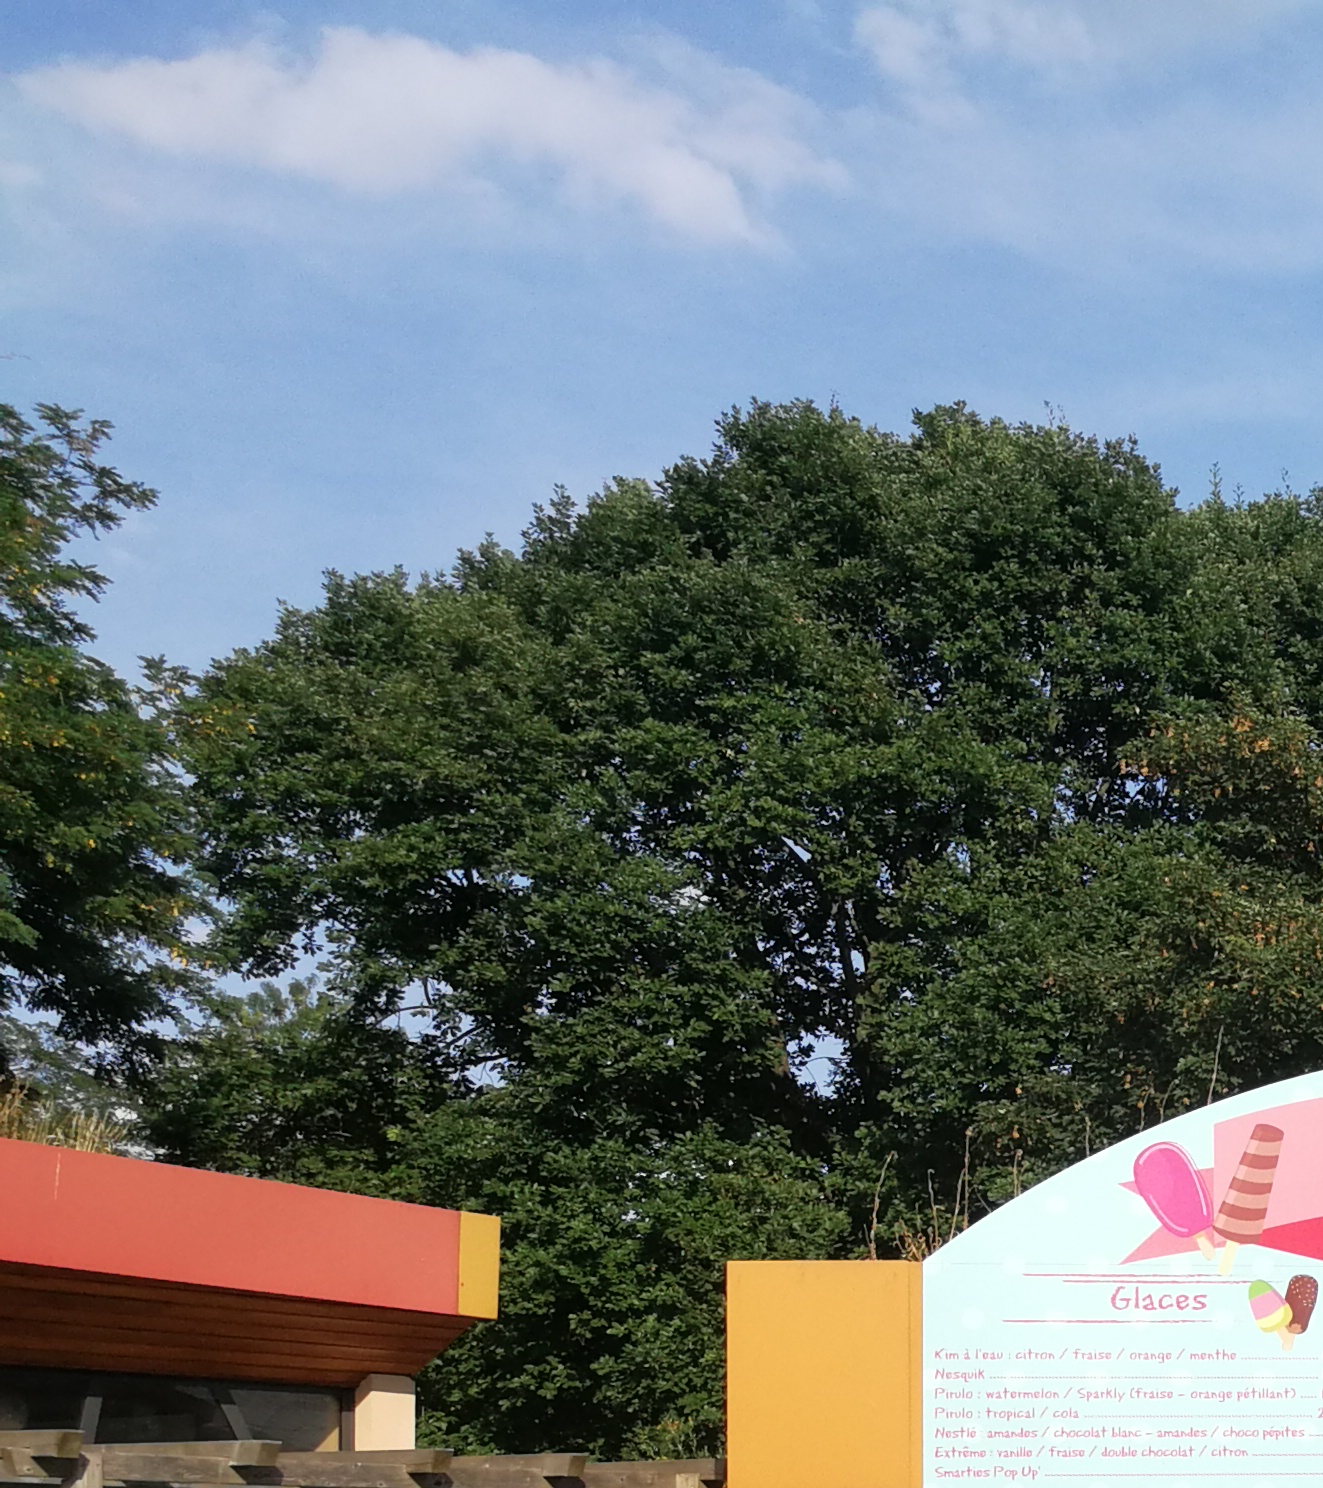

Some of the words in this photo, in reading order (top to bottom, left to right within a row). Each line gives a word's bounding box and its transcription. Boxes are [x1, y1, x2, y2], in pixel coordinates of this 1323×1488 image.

[1111, 1285, 1207, 1311] Glaces
[935, 1348, 959, 1359] Kim
[964, 1348, 970, 1360] à
[1016, 1348, 1055, 1360] citron
[1073, 1349, 1111, 1360] fraise
[1130, 1353, 1172, 1363] orange
[1190, 1349, 1236, 1360] menthe
[935, 1368, 984, 1383] Nesquik
[935, 1388, 973, 1399] Pirulo
[986, 1387, 1059, 1399] watermelon
[1077, 1387, 1125, 1402] Sparkly
[1191, 1391, 1232, 1402] orange
[935, 1407, 973, 1419] Pirulo
[986, 1407, 1035, 1421] tropical
[1053, 1407, 1079, 1418] cola
[987, 1427, 1038, 1438] amandes
[1054, 1426, 1108, 1438] chocolat
[1111, 1427, 1141, 1438] blanc
[1157, 1427, 1207, 1438] amandes
[1223, 1426, 1259, 1438] choco
[935, 1446, 986, 1458] Extrême
[997, 1447, 1032, 1458] vanille
[1049, 1446, 1085, 1457] fraise
[1101, 1446, 1137, 1457] double
[1141, 1446, 1195, 1457] chocolat
[1211, 1446, 1248, 1456] citron
[935, 1466, 990, 1478] Smarties
[994, 1466, 1018, 1480] Pop
